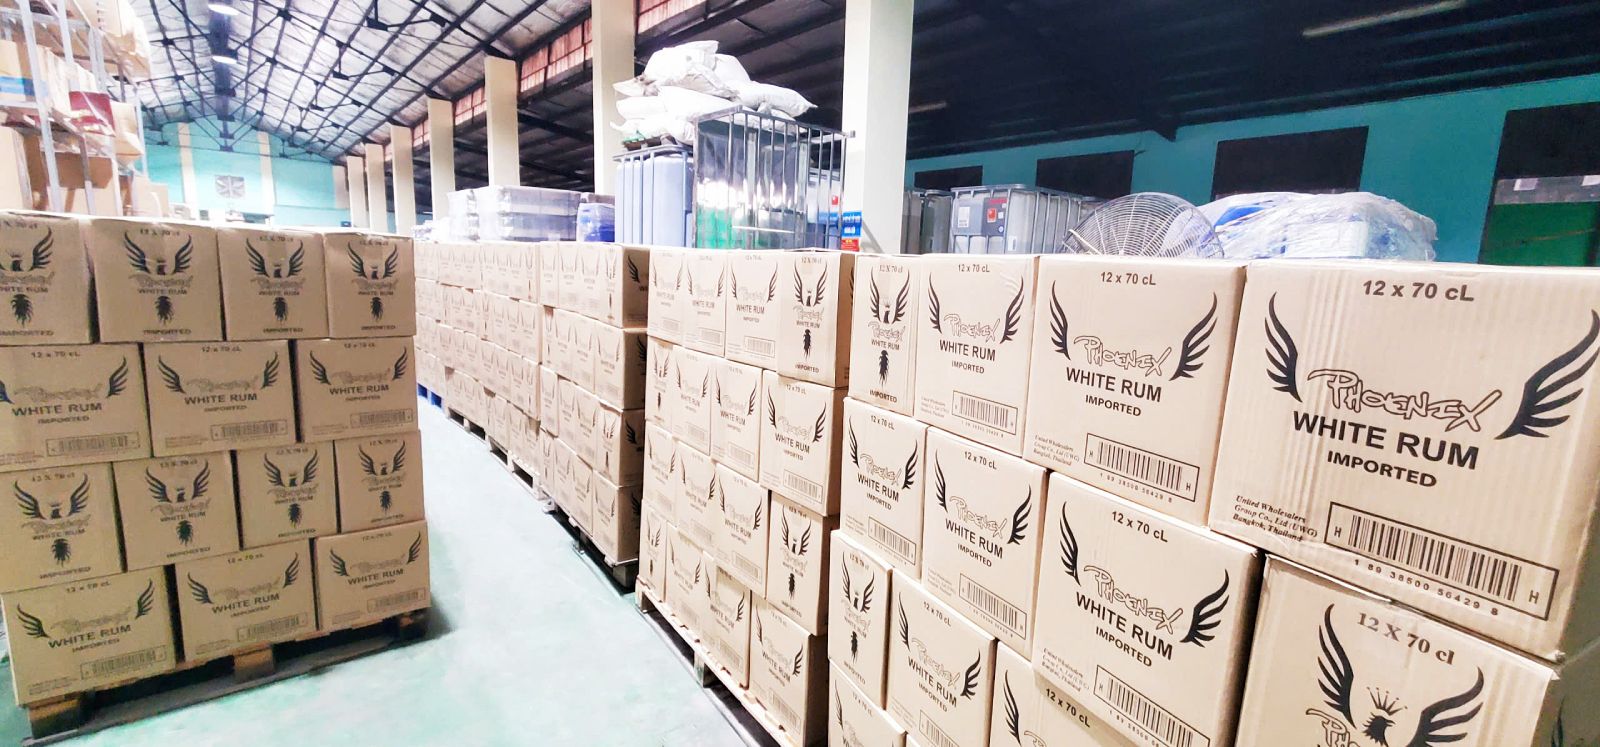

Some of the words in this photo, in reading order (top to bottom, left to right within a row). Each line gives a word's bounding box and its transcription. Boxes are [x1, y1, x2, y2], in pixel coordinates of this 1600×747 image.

[958, 264, 965, 272] 12
[972, 264, 980, 272] 70
[982, 264, 990, 272] cL
[1101, 272, 1112, 283] 12
[1116, 274, 1122, 283] x
[1126, 273, 1138, 284] 70
[1142, 274, 1156, 286] cL
[1363, 280, 1385, 296] 12
[1390, 284, 1404, 297] x
[1412, 282, 1437, 299] 70
[1444, 285, 1474, 302] cL
[940, 340, 969, 356] WHITE
[972, 346, 996, 362] RUM
[952, 361, 985, 374] IMPORTED
[329, 386, 362, 396] WHITE
[366, 384, 390, 392] RUM
[870, 390, 898, 402] IMPORTED
[1066, 367, 1116, 392] WHITE
[1121, 379, 1162, 402] RUM
[12, 404, 62, 416] WHITE
[68, 402, 102, 413] RUM
[184, 395, 226, 406] WHITE
[230, 392, 257, 402] RUM
[1085, 394, 1142, 417] IMPORTED
[1293, 410, 1386, 450] WHITE
[1396, 431, 1479, 470] RUM
[964, 451, 972, 460] 12
[978, 456, 987, 466] 70
[988, 460, 997, 470] cL
[1327, 450, 1437, 488] IMPORTED
[858, 472, 880, 493] WHITE
[882, 484, 900, 502] RUM
[1234, 504, 1258, 518] Group
[1274, 516, 1289, 528] Ltd
[1288, 520, 1318, 538] (UWG)
[1235, 494, 1260, 508] United
[1260, 501, 1306, 523] Wholesalers
[946, 518, 976, 544] WHITE
[978, 536, 1003, 559] RUM
[1112, 511, 1123, 524] 12
[1126, 518, 1134, 528] x
[1137, 520, 1150, 534] 70
[1154, 528, 1168, 543] cL
[958, 544, 992, 567] IMPORTED
[348, 572, 380, 586] WHITE
[382, 568, 404, 578] RUM
[1354, 558, 1360, 566] 1
[1367, 563, 1382, 574] 89
[1390, 570, 1430, 591] 38500
[1437, 588, 1481, 609] 56429
[1491, 606, 1499, 616] 8
[211, 599, 250, 614] WHITE
[254, 592, 280, 604] RUM
[48, 630, 96, 648] WHITE
[100, 624, 132, 638] RUM
[1076, 592, 1126, 633] WHITE
[1132, 624, 1173, 661] RUM
[1358, 612, 1380, 630] 12
[1384, 620, 1402, 642] X
[1406, 633, 1430, 654] 70
[1436, 648, 1456, 665] cl
[1096, 626, 1152, 667] IMPORTED
[908, 656, 934, 687] WHITE
[936, 682, 957, 708] RUM
[918, 682, 947, 712] IMPORTED
[1046, 688, 1056, 702] 12
[1058, 698, 1064, 708] x
[1066, 702, 1077, 718] 70
[1079, 712, 1091, 728] cL
